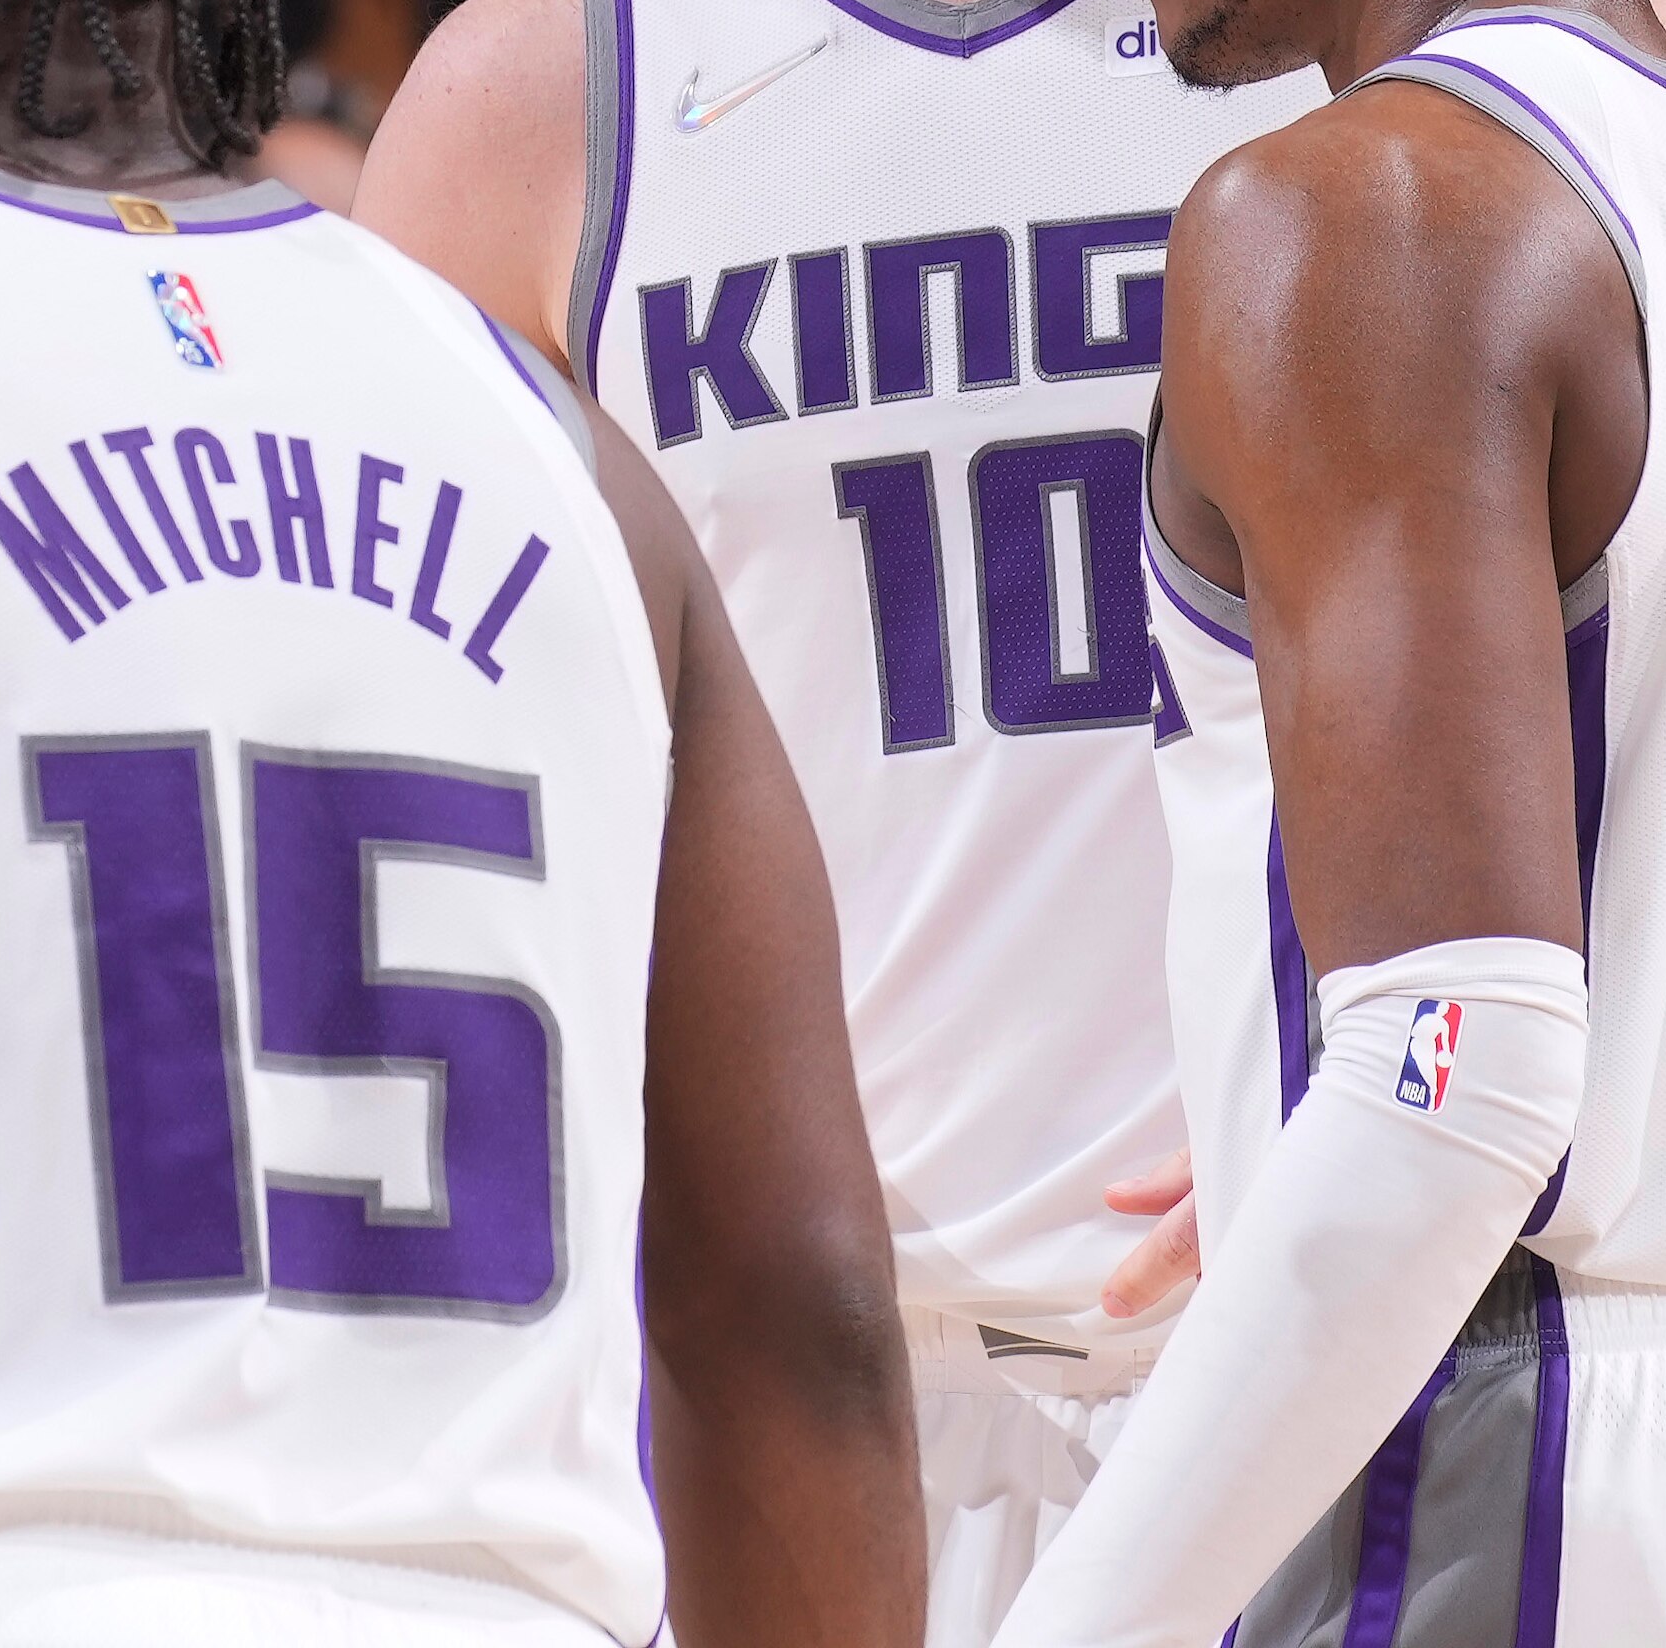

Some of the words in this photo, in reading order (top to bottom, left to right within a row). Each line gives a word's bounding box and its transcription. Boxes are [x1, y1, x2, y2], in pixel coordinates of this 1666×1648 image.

[1116, 20, 1156, 59] di
[831, 428, 1155, 755] 10
[20, 729, 568, 1324] 15
[1400, 1080, 1427, 1104] NBA
